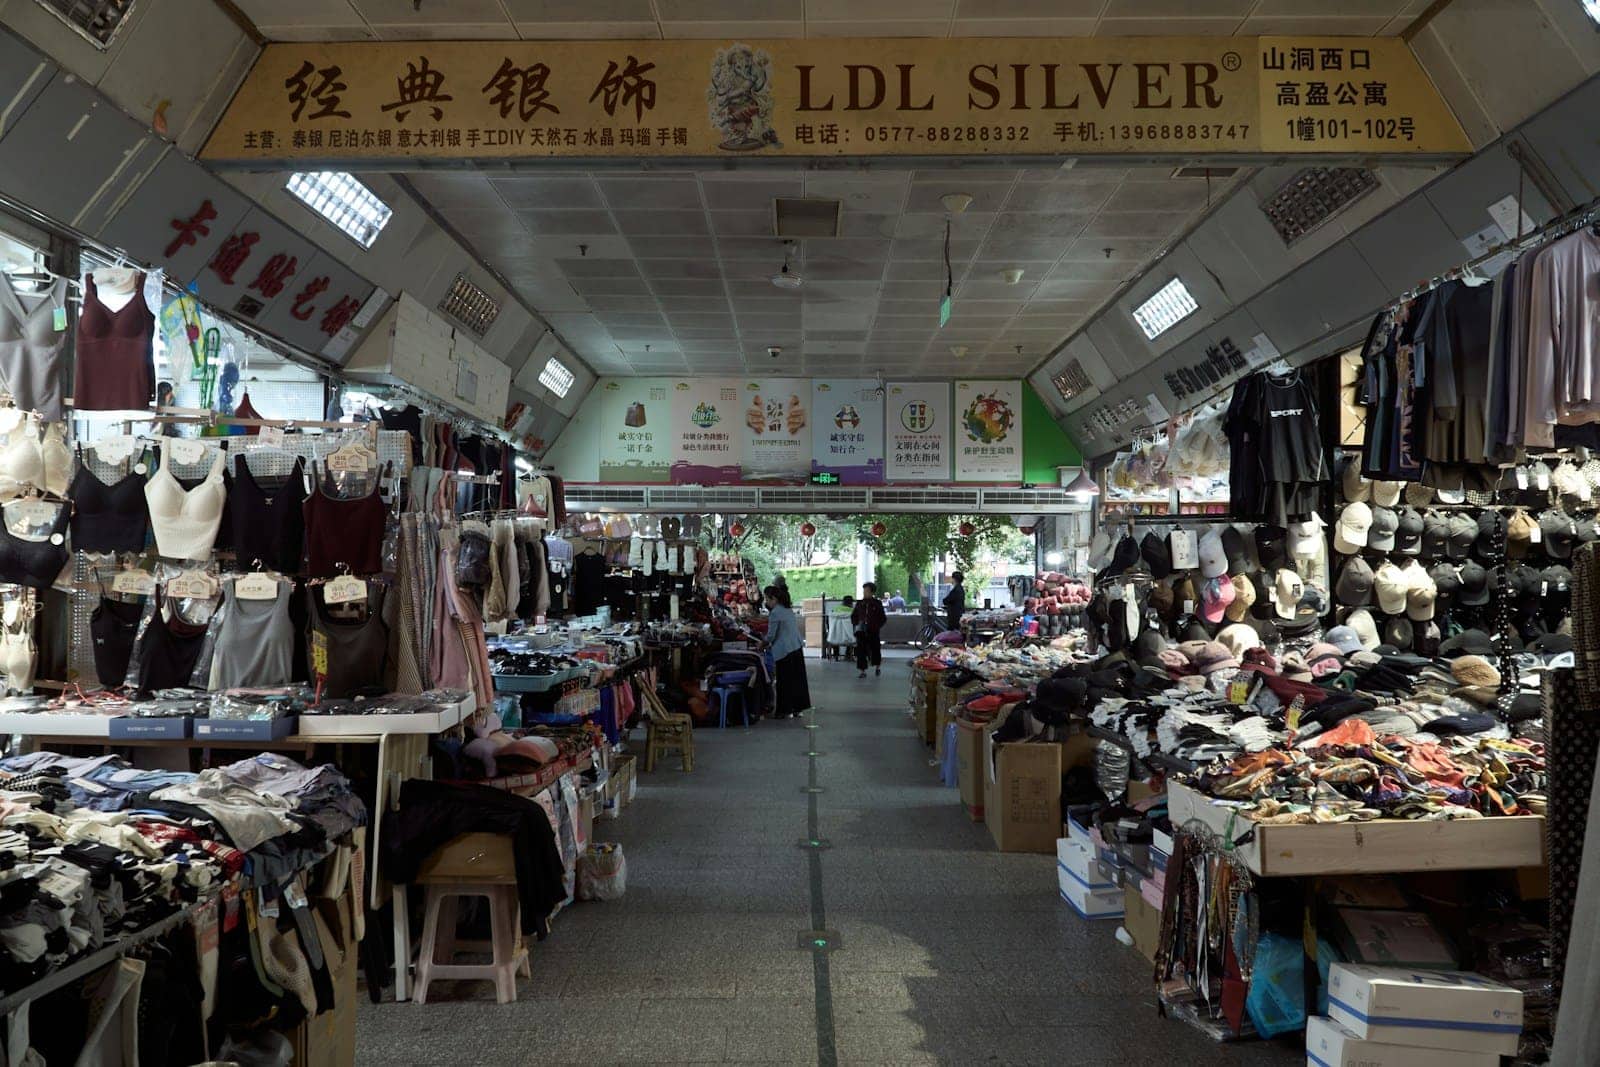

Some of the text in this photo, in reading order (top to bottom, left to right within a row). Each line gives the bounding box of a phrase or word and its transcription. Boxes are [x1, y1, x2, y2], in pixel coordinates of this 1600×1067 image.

[1262, 46, 1371, 71] 山洞西口
[284, 55, 658, 123] 经典银饰
[795, 63, 935, 112] LDL
[968, 62, 1224, 112] SILVER
[1275, 81, 1388, 106] 高盈公寓
[327, 129, 392, 148] 尼泊尔银
[396, 128, 461, 148] 意大利银
[466, 128, 525, 148] 手工DIY
[530, 128, 578, 147] 天然石
[583, 127, 615, 147] 水晶
[865, 125, 1030, 143] 0577-88288332
[1286, 116, 1416, 142] 1幢101-102号
